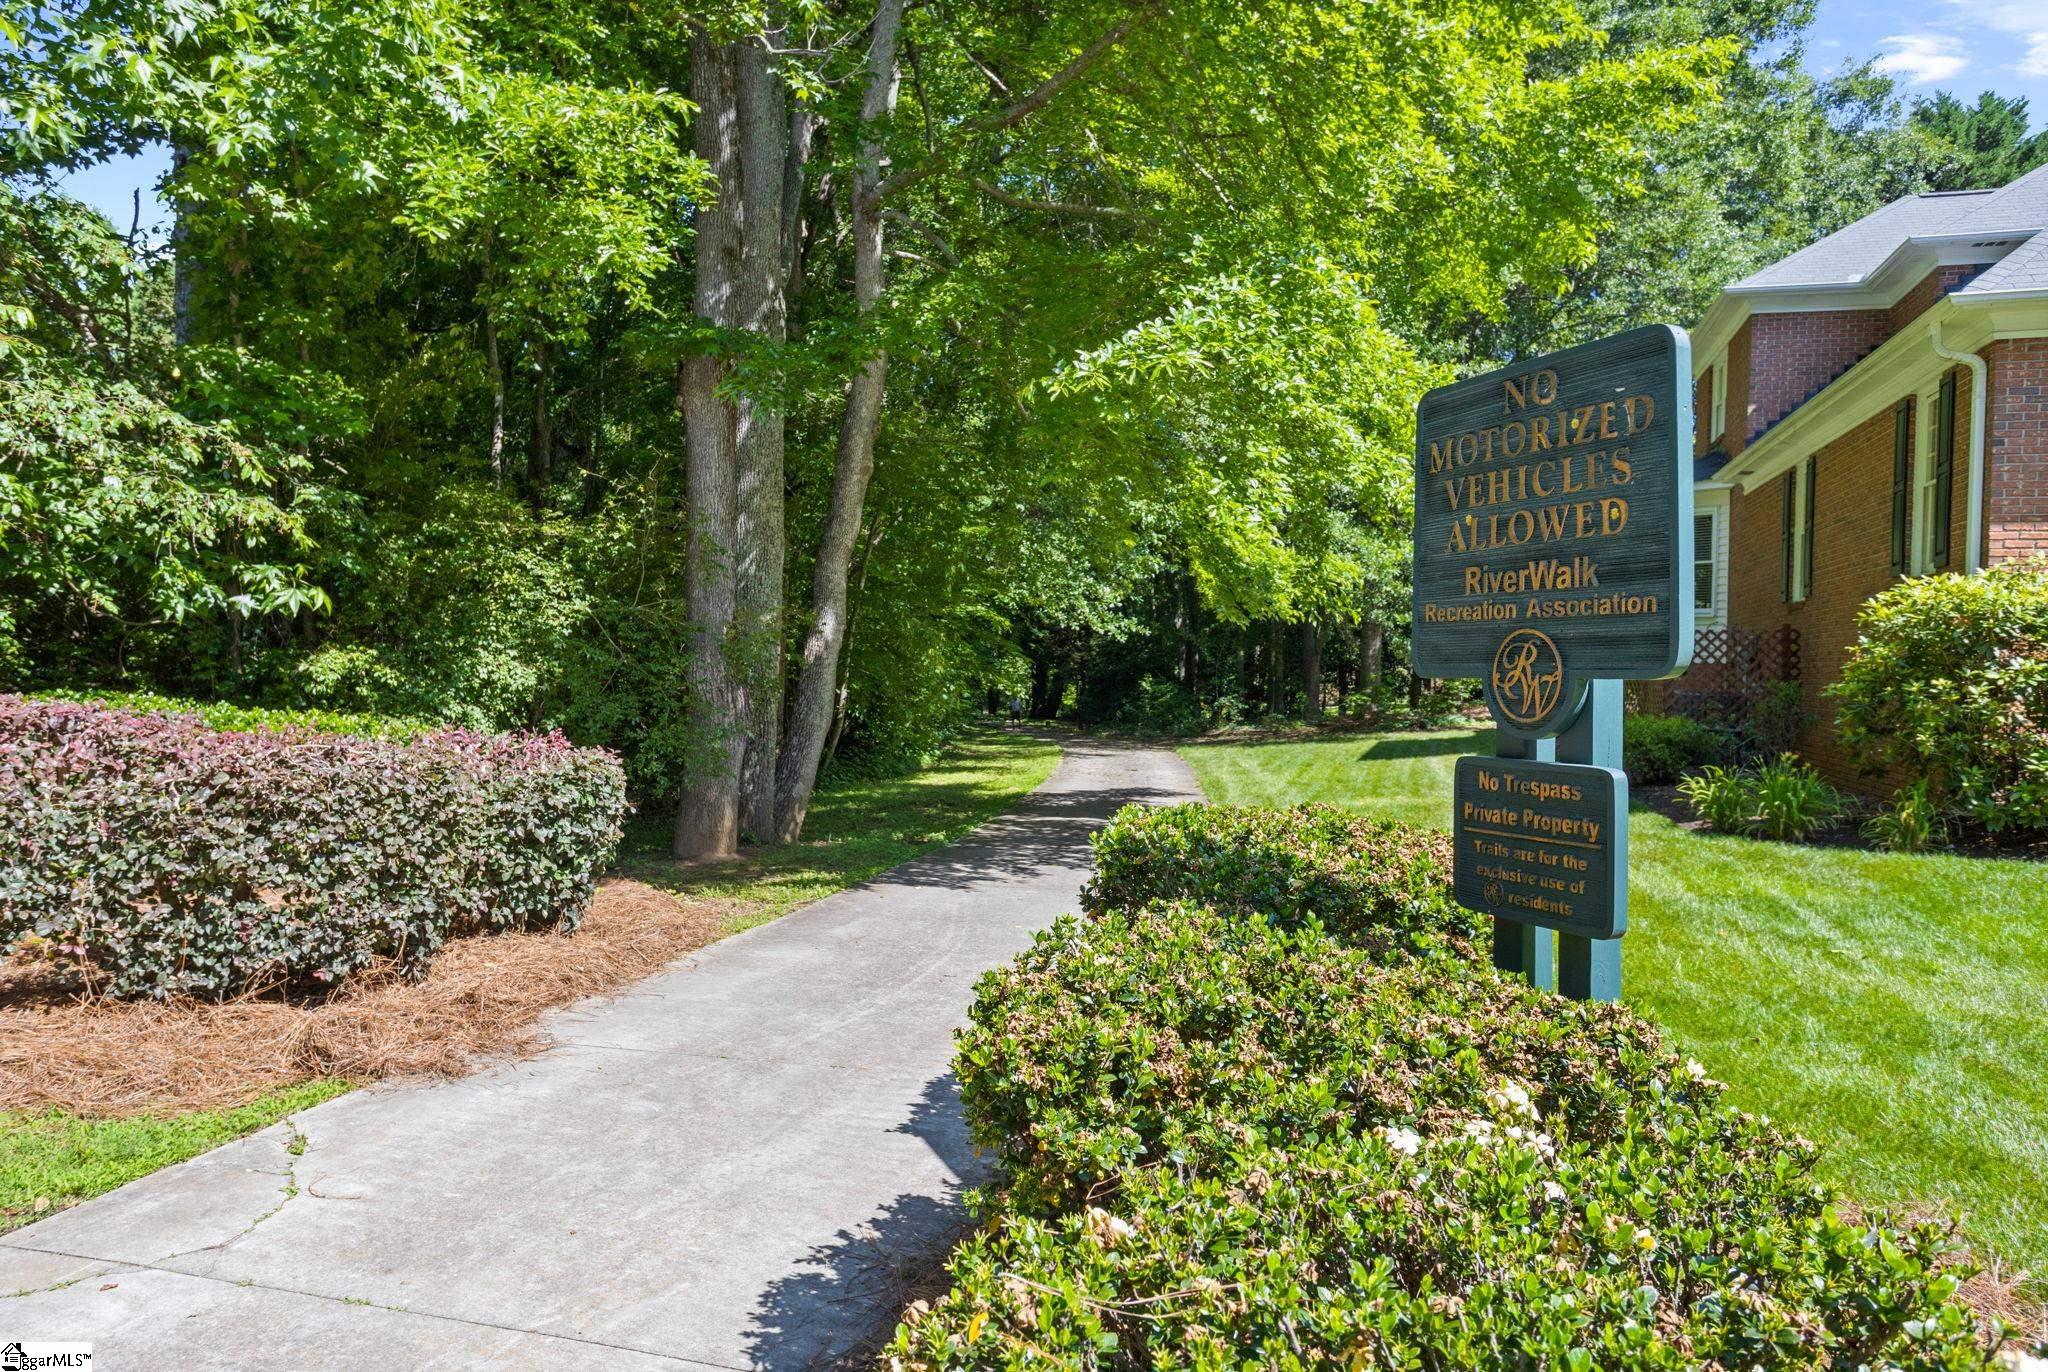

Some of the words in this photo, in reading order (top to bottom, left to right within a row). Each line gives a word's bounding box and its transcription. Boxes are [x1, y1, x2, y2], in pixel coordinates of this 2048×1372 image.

[1503, 369, 1558, 415] NO
[1429, 394, 1655, 475] MOTORIZED
[1444, 447, 1633, 511] VEHICLES
[1445, 496, 1629, 554] ALLOWED
[1465, 556, 1599, 596] RiverWalk
[1424, 599, 1516, 624] Recreation
[1526, 594, 1657, 619] Association
[1478, 770, 1499, 792] No
[1503, 773, 1582, 801] Trespass
[1464, 802, 1518, 826] Private
[1522, 808, 1600, 843] Property
[1474, 839, 1509, 858] Trails
[1513, 847, 1535, 863] are
[1538, 848, 1558, 866] for
[1562, 853, 1588, 872] the
[1476, 864, 1537, 886] exclusive
[1540, 875, 1565, 891] use
[1569, 879, 1585, 895] of
[1508, 892, 1574, 916] residents
